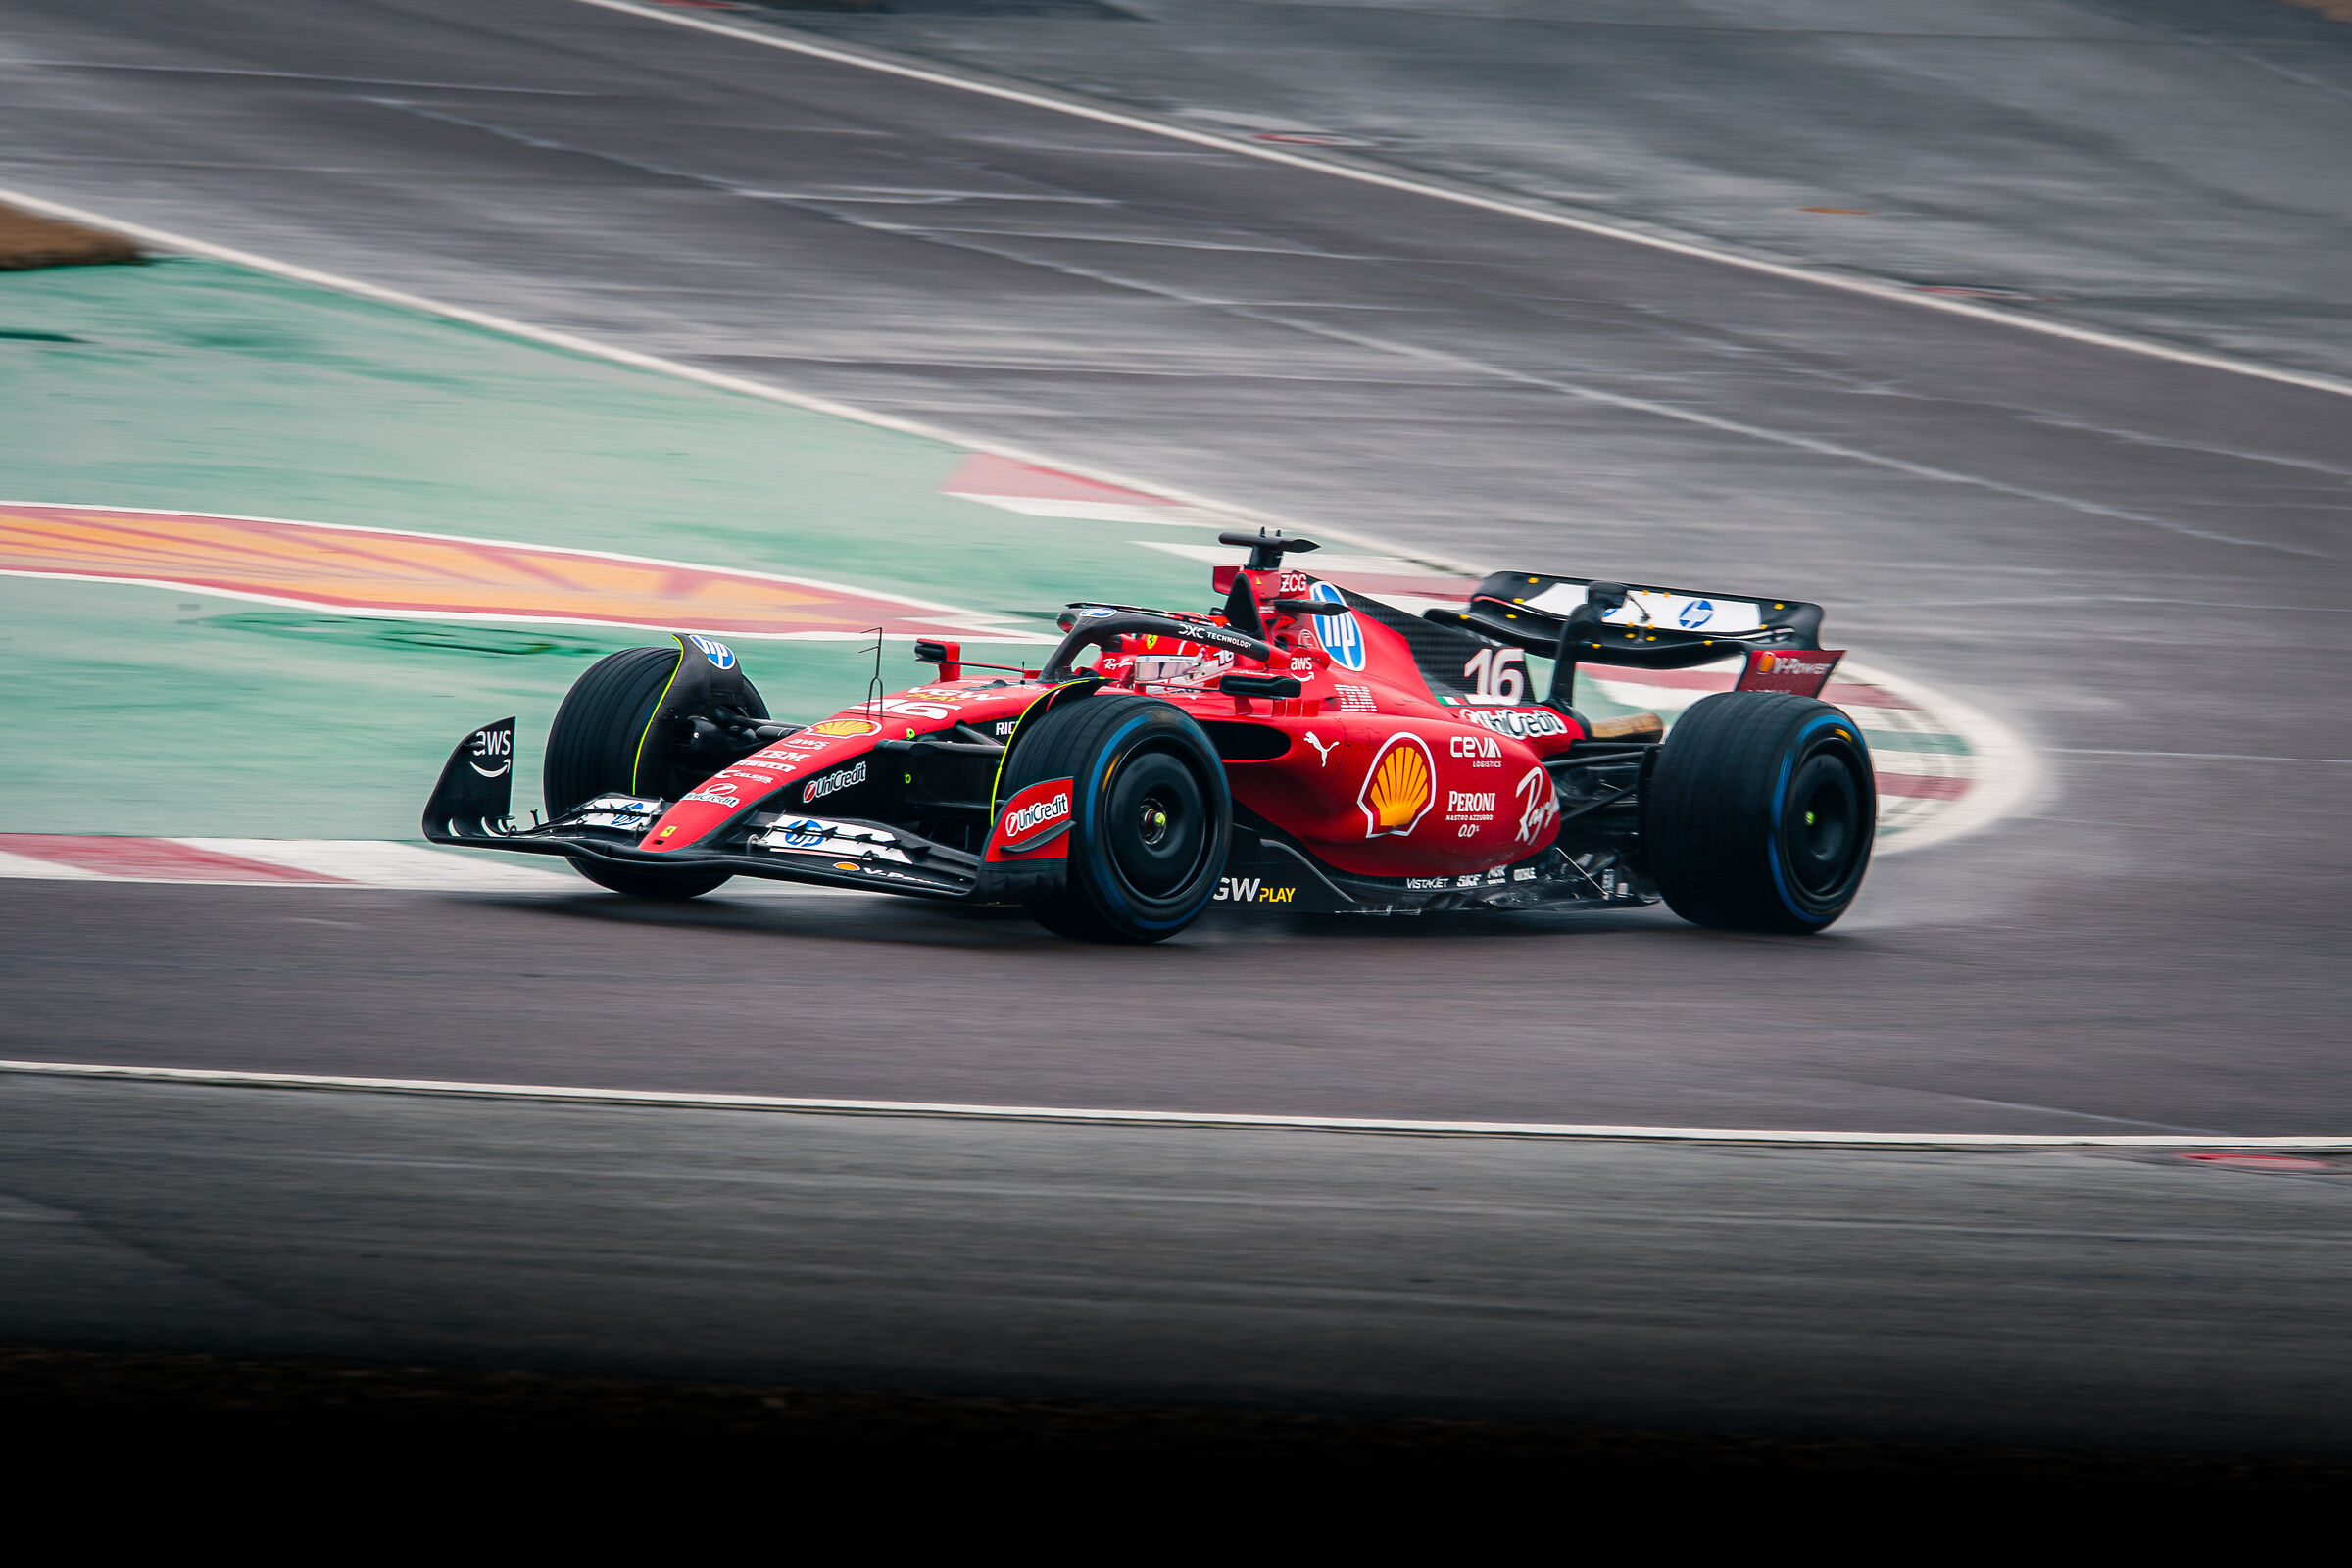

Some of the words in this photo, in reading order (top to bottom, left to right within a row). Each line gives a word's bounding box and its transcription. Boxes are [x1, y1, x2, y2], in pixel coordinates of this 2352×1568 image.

[1178, 623, 1206, 639] DXC
[1206, 631, 1252, 649] TECHNOLOGY
[691, 635, 735, 670] hp
[1291, 657, 1313, 671] aws
[1464, 648, 1525, 706] 16
[907, 687, 1007, 701] VGW
[849, 698, 963, 720] 16
[472, 730, 511, 756] aws
[753, 750, 811, 762] IBM
[816, 761, 866, 797] UniCredit
[1018, 794, 1068, 829] UniCredit
[1447, 791, 1496, 812] PERONI
[1213, 877, 1261, 902] GW
[1258, 887, 1296, 903] PLAY
[1456, 874, 1482, 887] SKF
